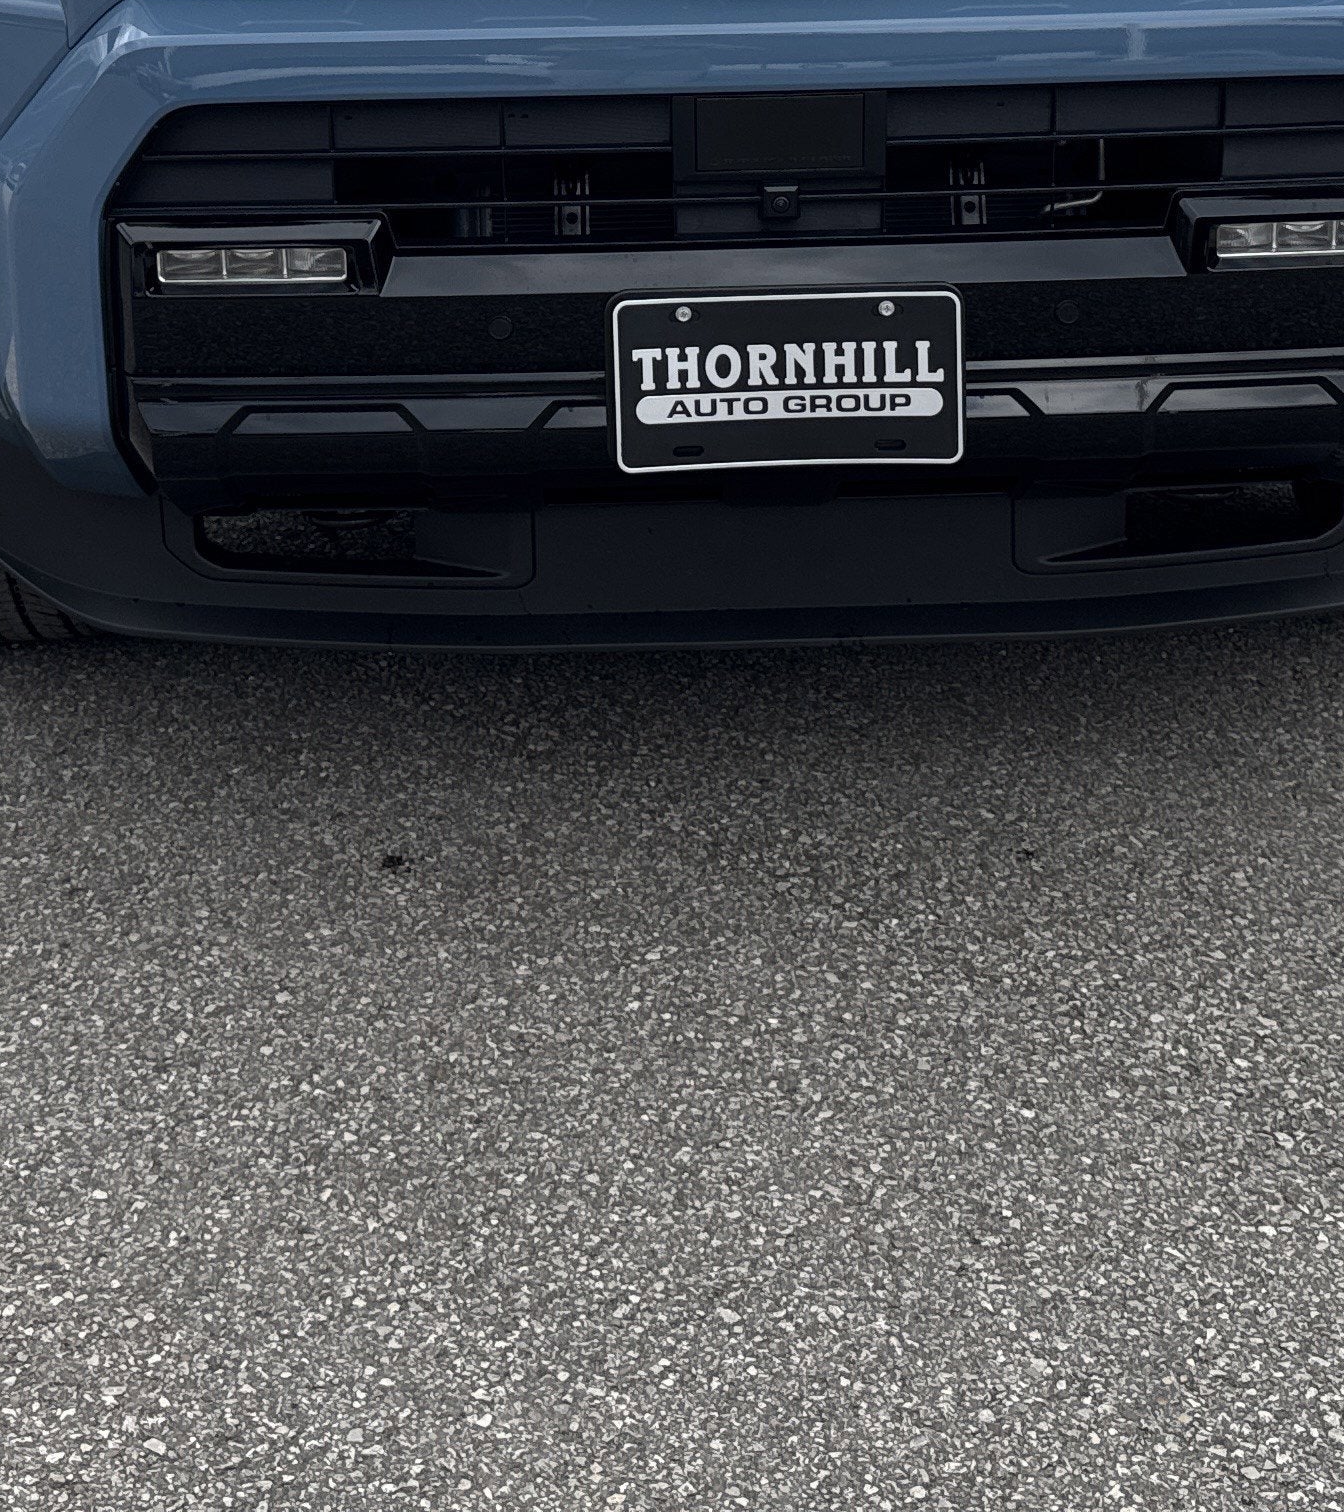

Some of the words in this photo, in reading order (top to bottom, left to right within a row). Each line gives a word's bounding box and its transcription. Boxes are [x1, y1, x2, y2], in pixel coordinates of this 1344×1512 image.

[631, 340, 944, 391] THORNHILL
[666, 395, 769, 419] AUTO
[783, 393, 912, 414] GROUP
